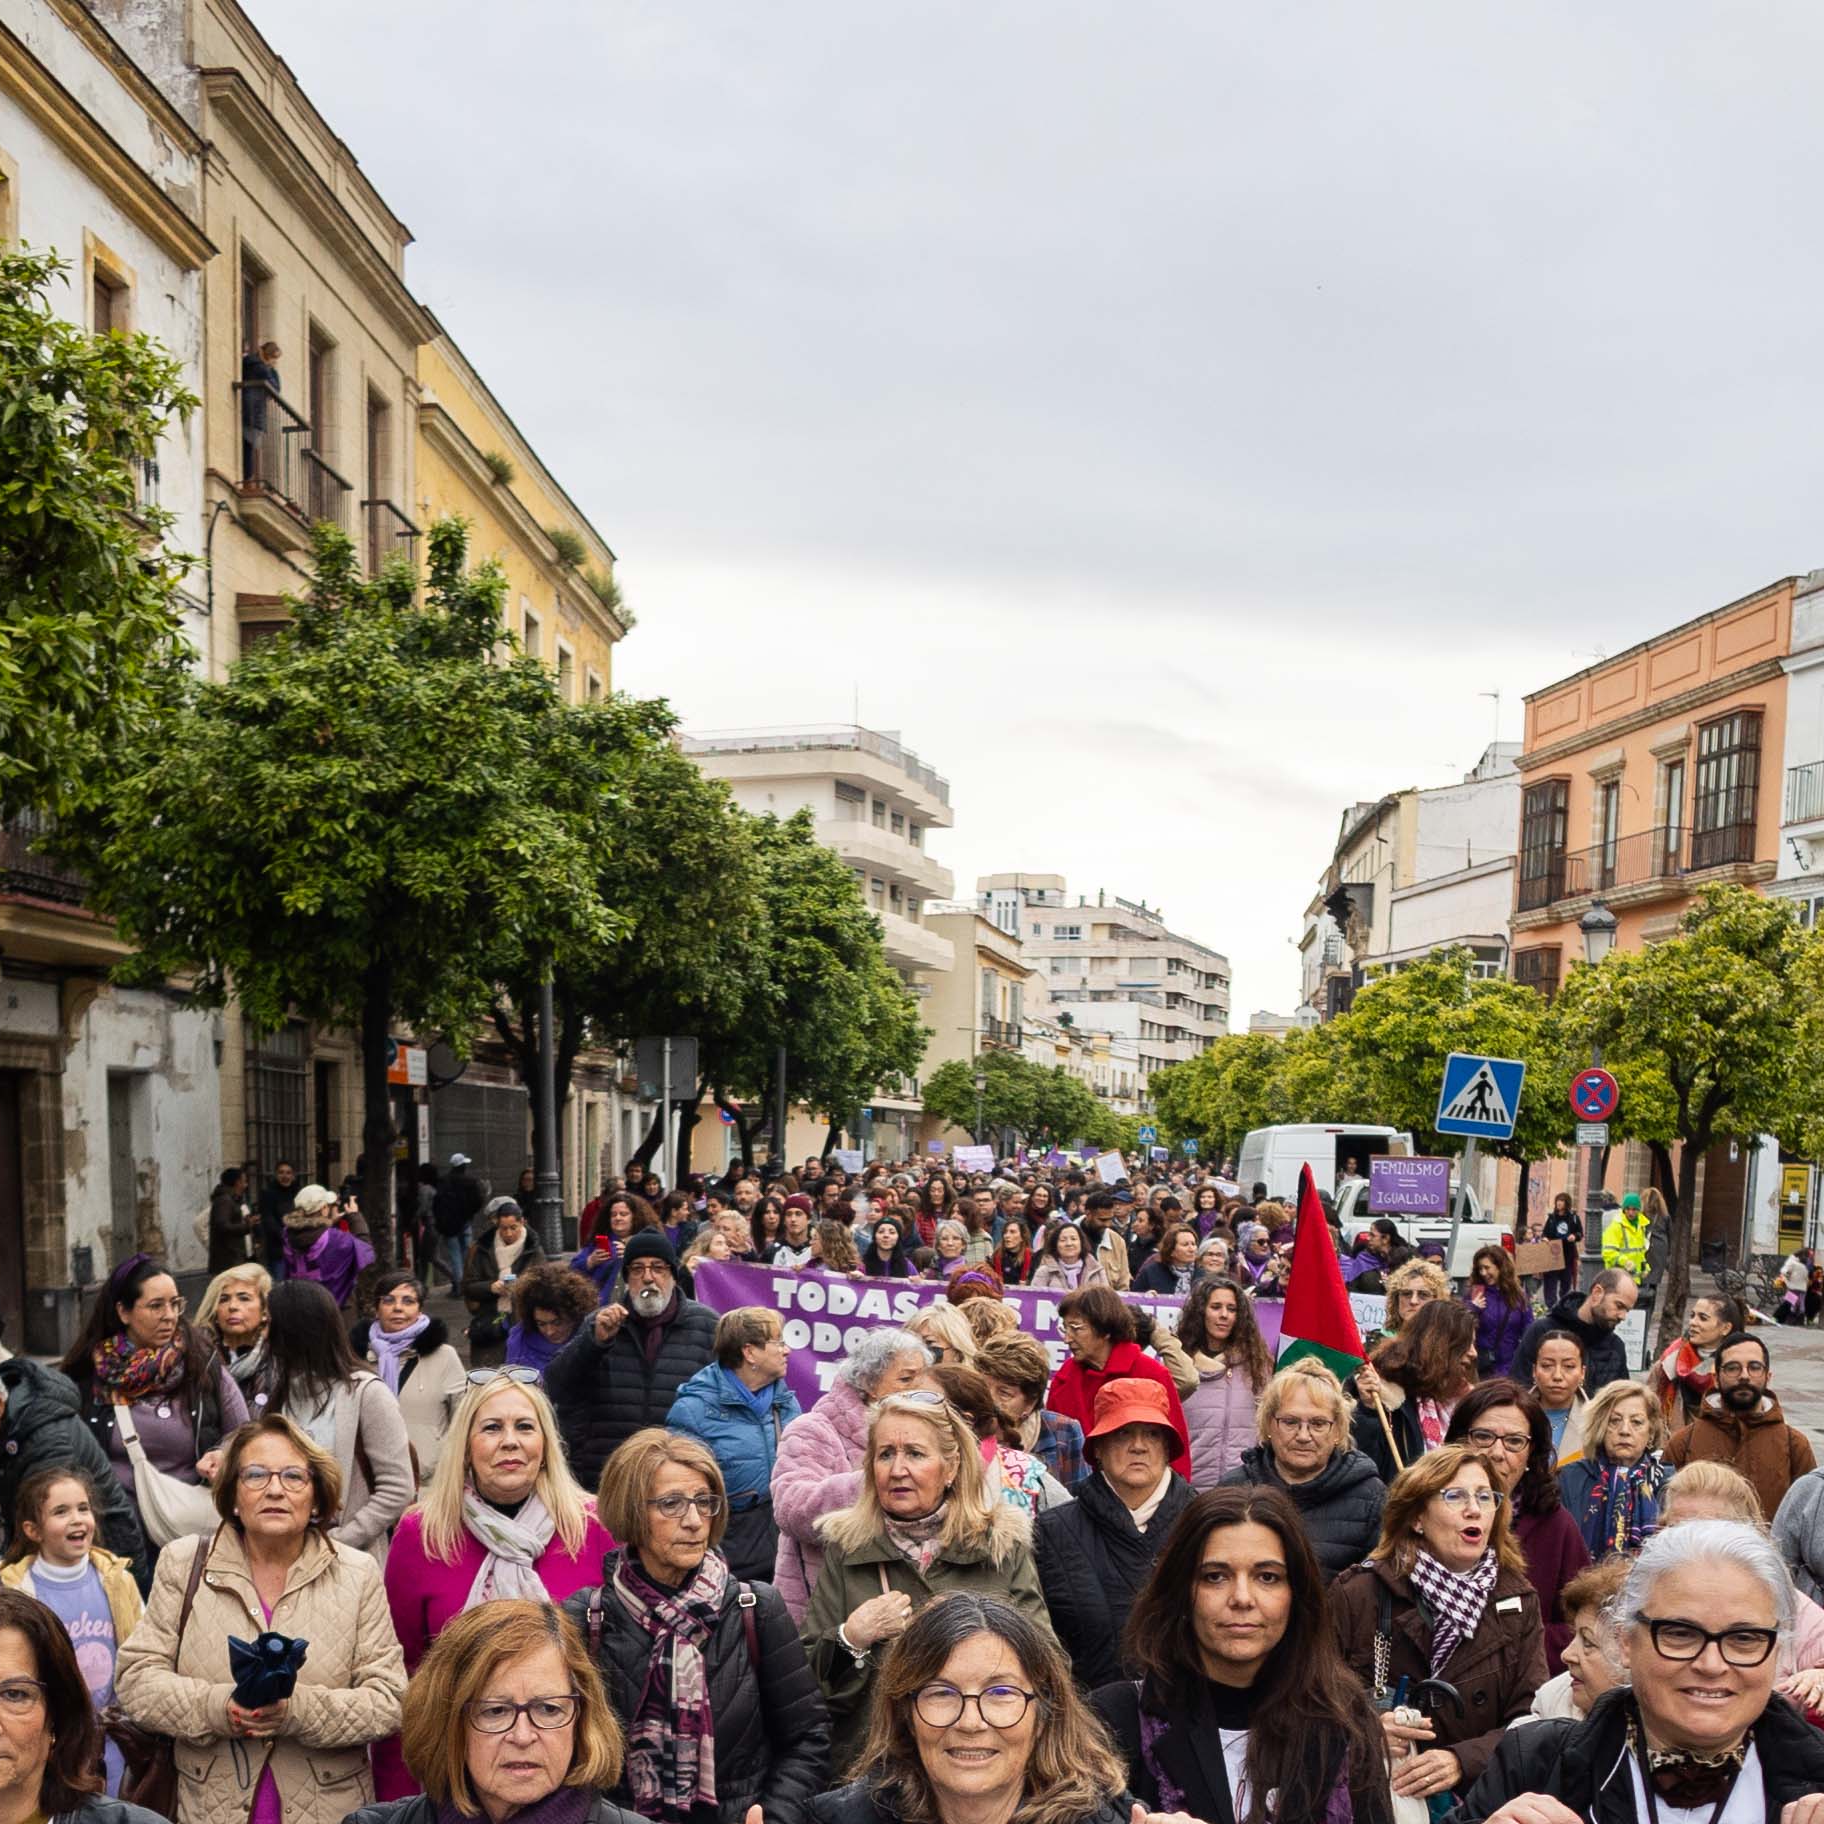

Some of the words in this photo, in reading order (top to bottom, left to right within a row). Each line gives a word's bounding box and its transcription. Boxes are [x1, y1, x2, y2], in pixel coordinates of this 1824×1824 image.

[1372, 1161, 1444, 1176] FEMINISMO
[1377, 1191, 1440, 1205] IGUALDAD
[773, 1278, 920, 1322] TODAS
